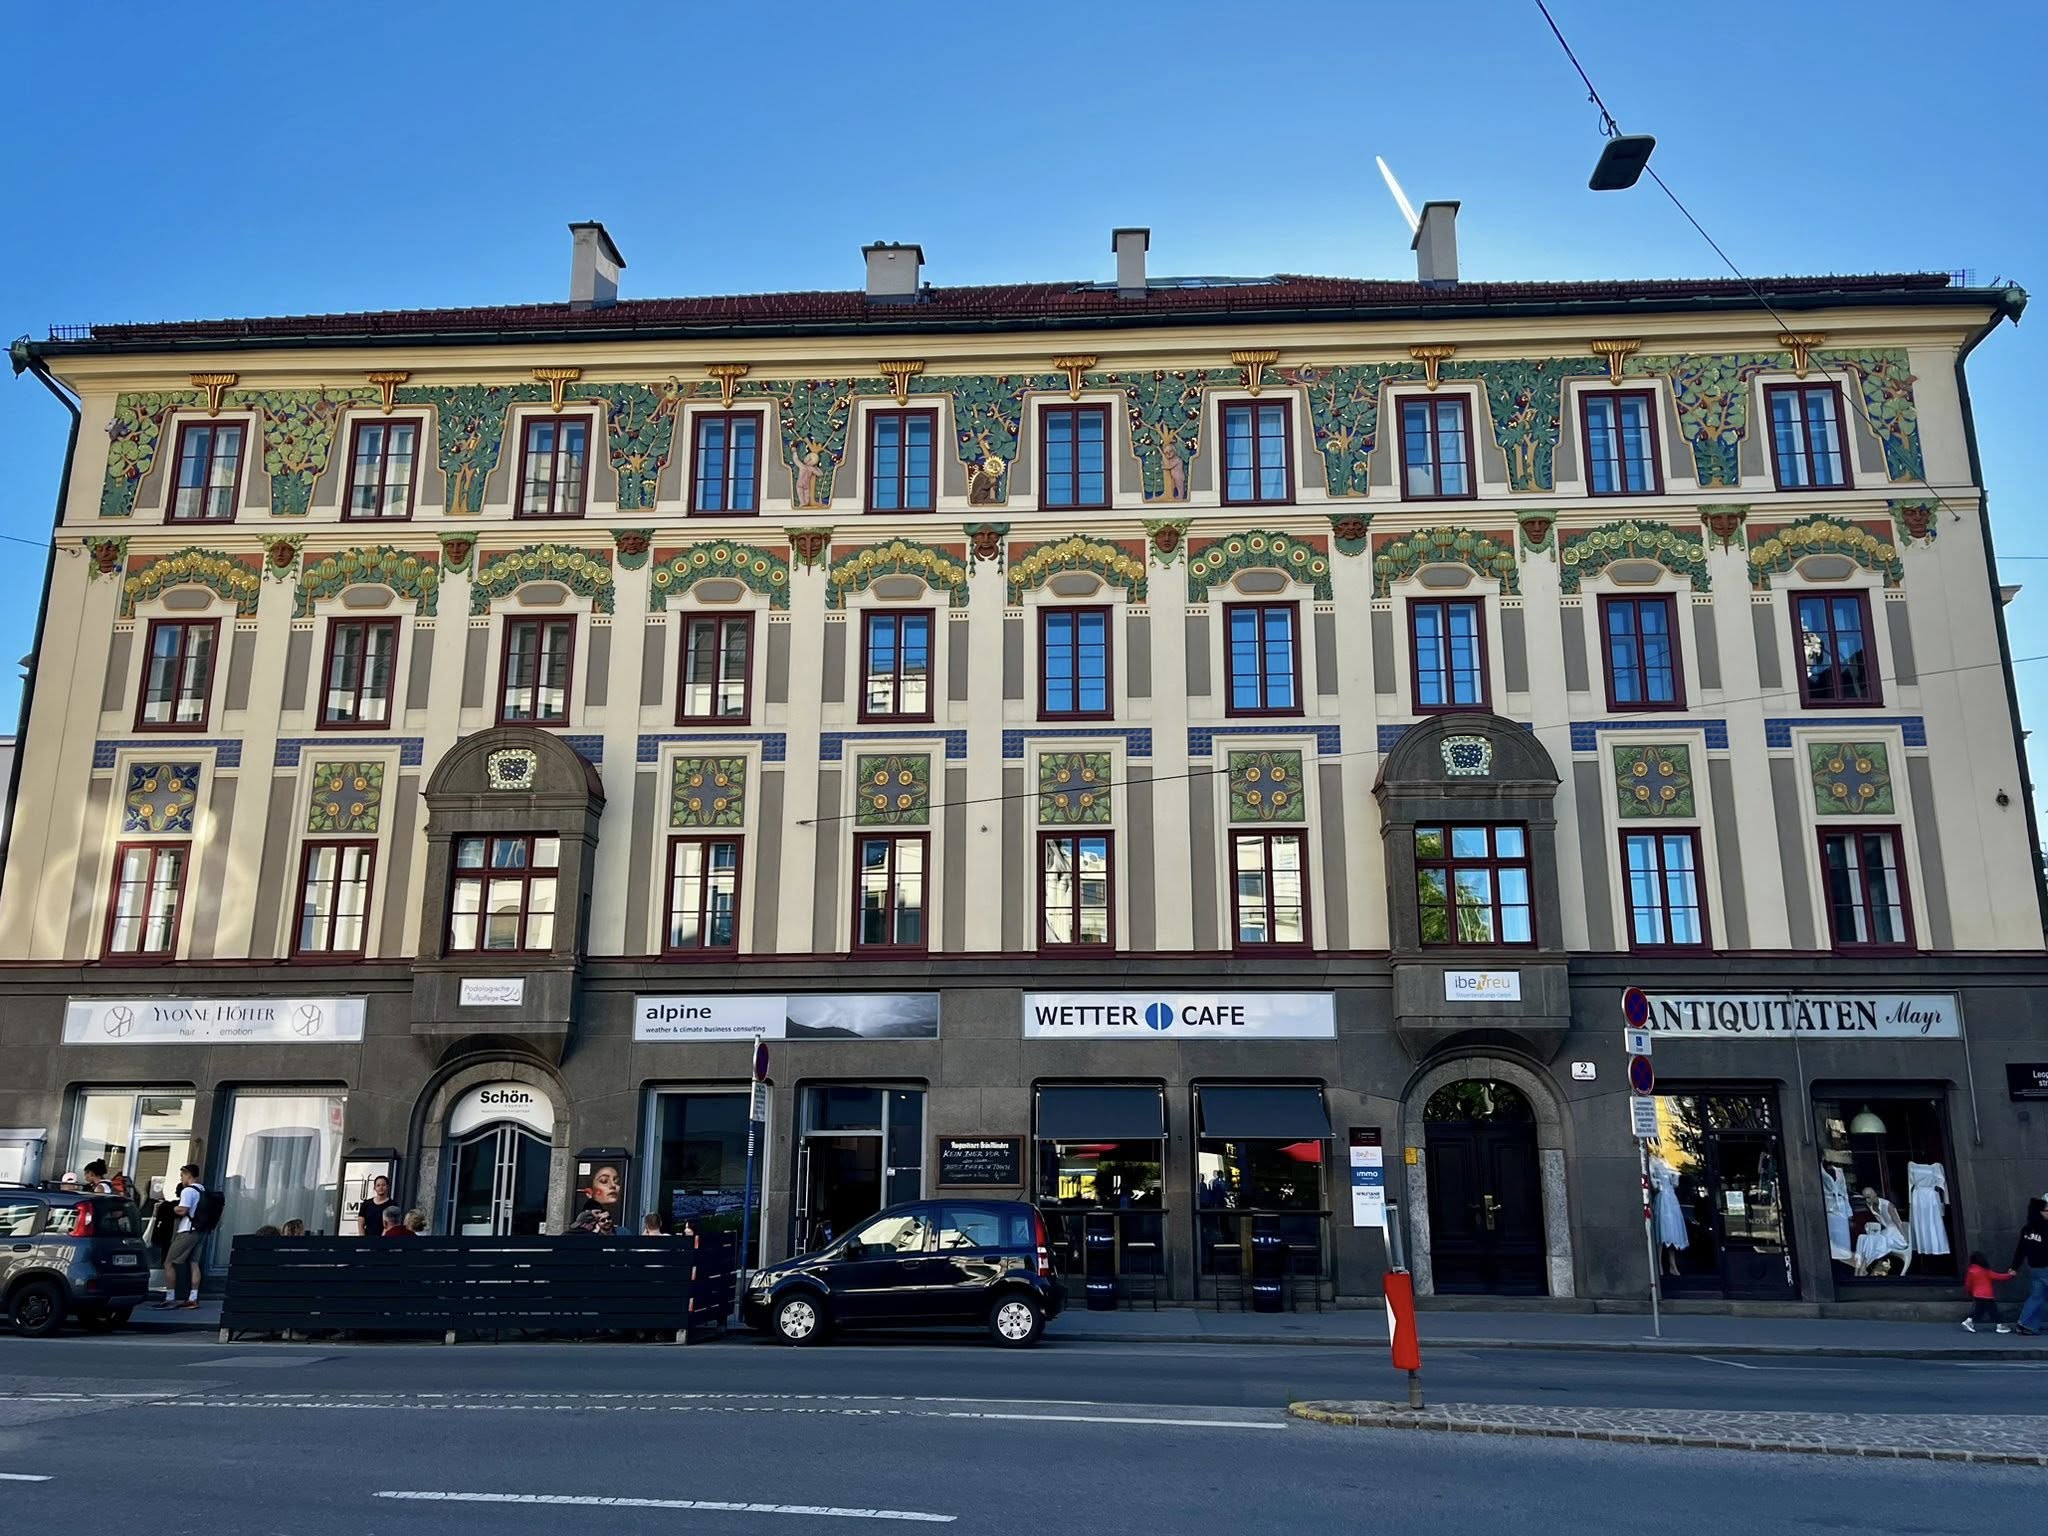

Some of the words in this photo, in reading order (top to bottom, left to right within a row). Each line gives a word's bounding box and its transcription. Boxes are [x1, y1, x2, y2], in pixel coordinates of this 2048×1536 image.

[153, 1006, 210, 1022] YVONNE
[646, 1004, 712, 1022] alpine
[1035, 1006, 1138, 1025] WETTER
[1182, 1006, 1245, 1025] CAFE
[1643, 998, 1878, 1031] ANTIQUITÄTEN
[1885, 1001, 1942, 1034] Mayr
[179, 1027, 195, 1036] hair
[219, 1027, 253, 1036] emotion
[733, 1025, 766, 1033] consulting
[1580, 1062, 1588, 1074] 2
[480, 1090, 533, 1103] Schön.
[942, 1150, 962, 1158] KEIN
